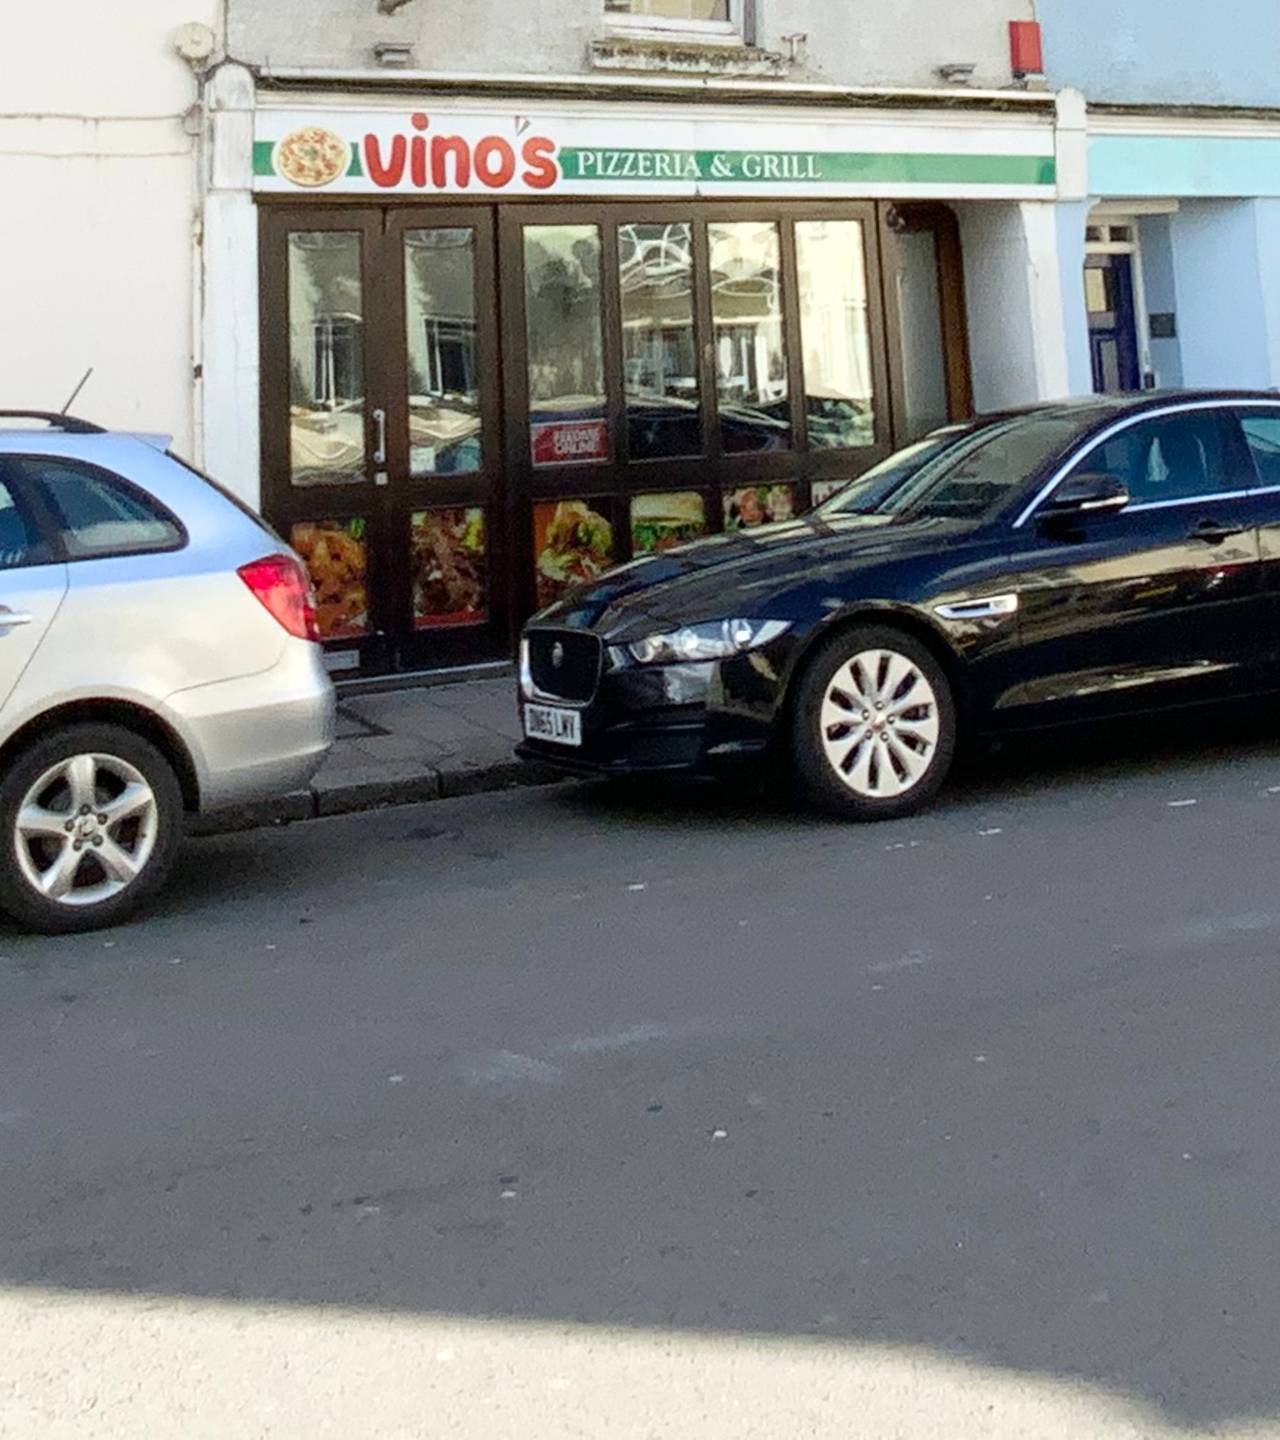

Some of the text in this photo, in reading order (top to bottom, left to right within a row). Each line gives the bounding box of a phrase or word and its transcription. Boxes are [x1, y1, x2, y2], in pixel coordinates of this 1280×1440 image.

[364, 112, 823, 189] vino's PIZZERIA & GRILL
